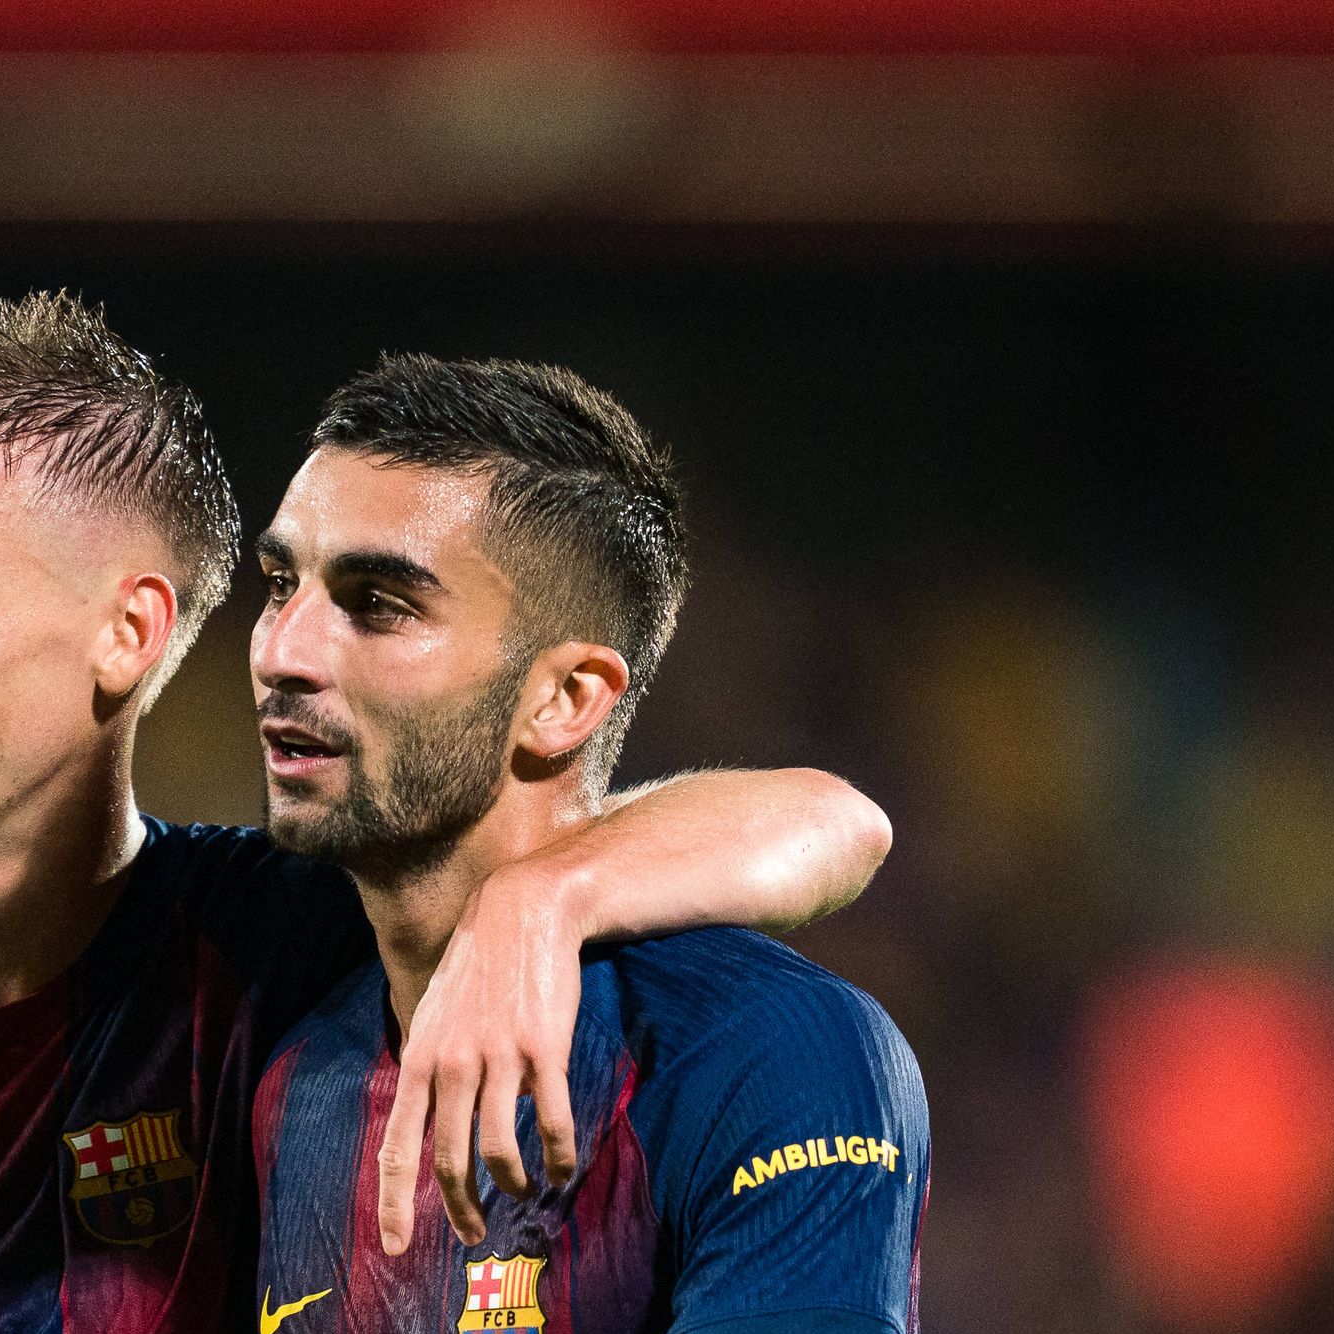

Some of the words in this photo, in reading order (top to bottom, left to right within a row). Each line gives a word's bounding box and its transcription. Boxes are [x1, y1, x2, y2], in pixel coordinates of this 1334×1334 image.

[732, 1135, 900, 1196] AMBILIGHT
[108, 1167, 157, 1190] FCB
[483, 1311, 516, 1327] FCB
